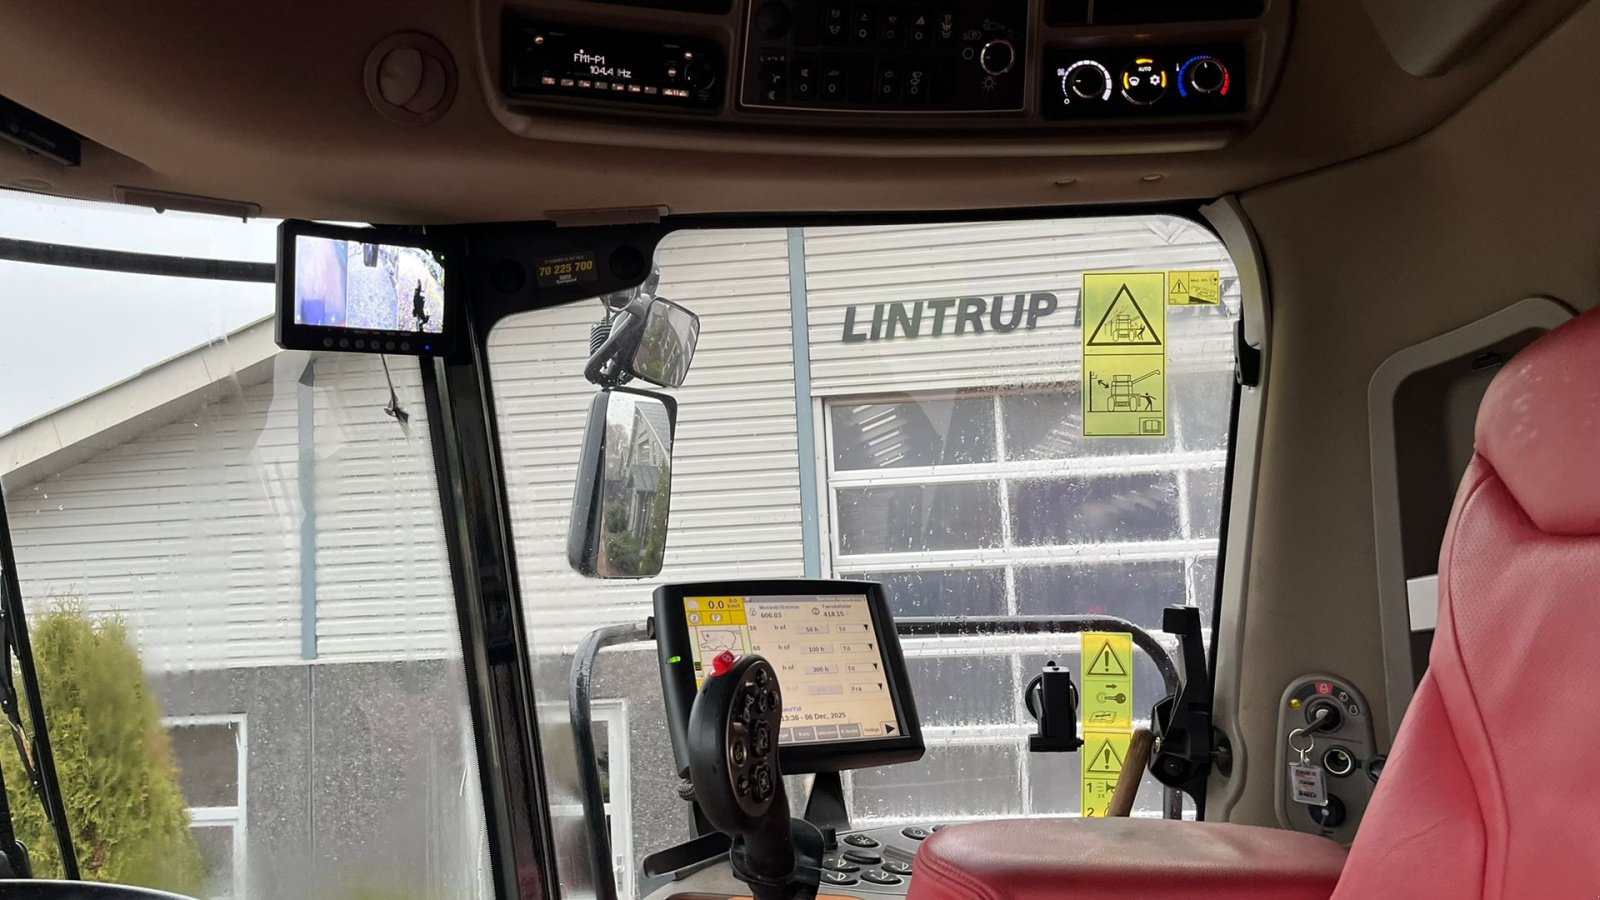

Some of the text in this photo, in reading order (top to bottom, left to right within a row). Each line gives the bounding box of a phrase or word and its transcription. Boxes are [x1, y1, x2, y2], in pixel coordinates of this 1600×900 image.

[574, 53, 605, 64] FM1-P1
[590, 66, 614, 76] 104.4
[540, 260, 592, 276] 70 225 700
[842, 292, 1058, 343] LINTRUP
[708, 600, 724, 609] 0.0
[1086, 782, 1092, 793] 1
[1087, 807, 1094, 817] 2
